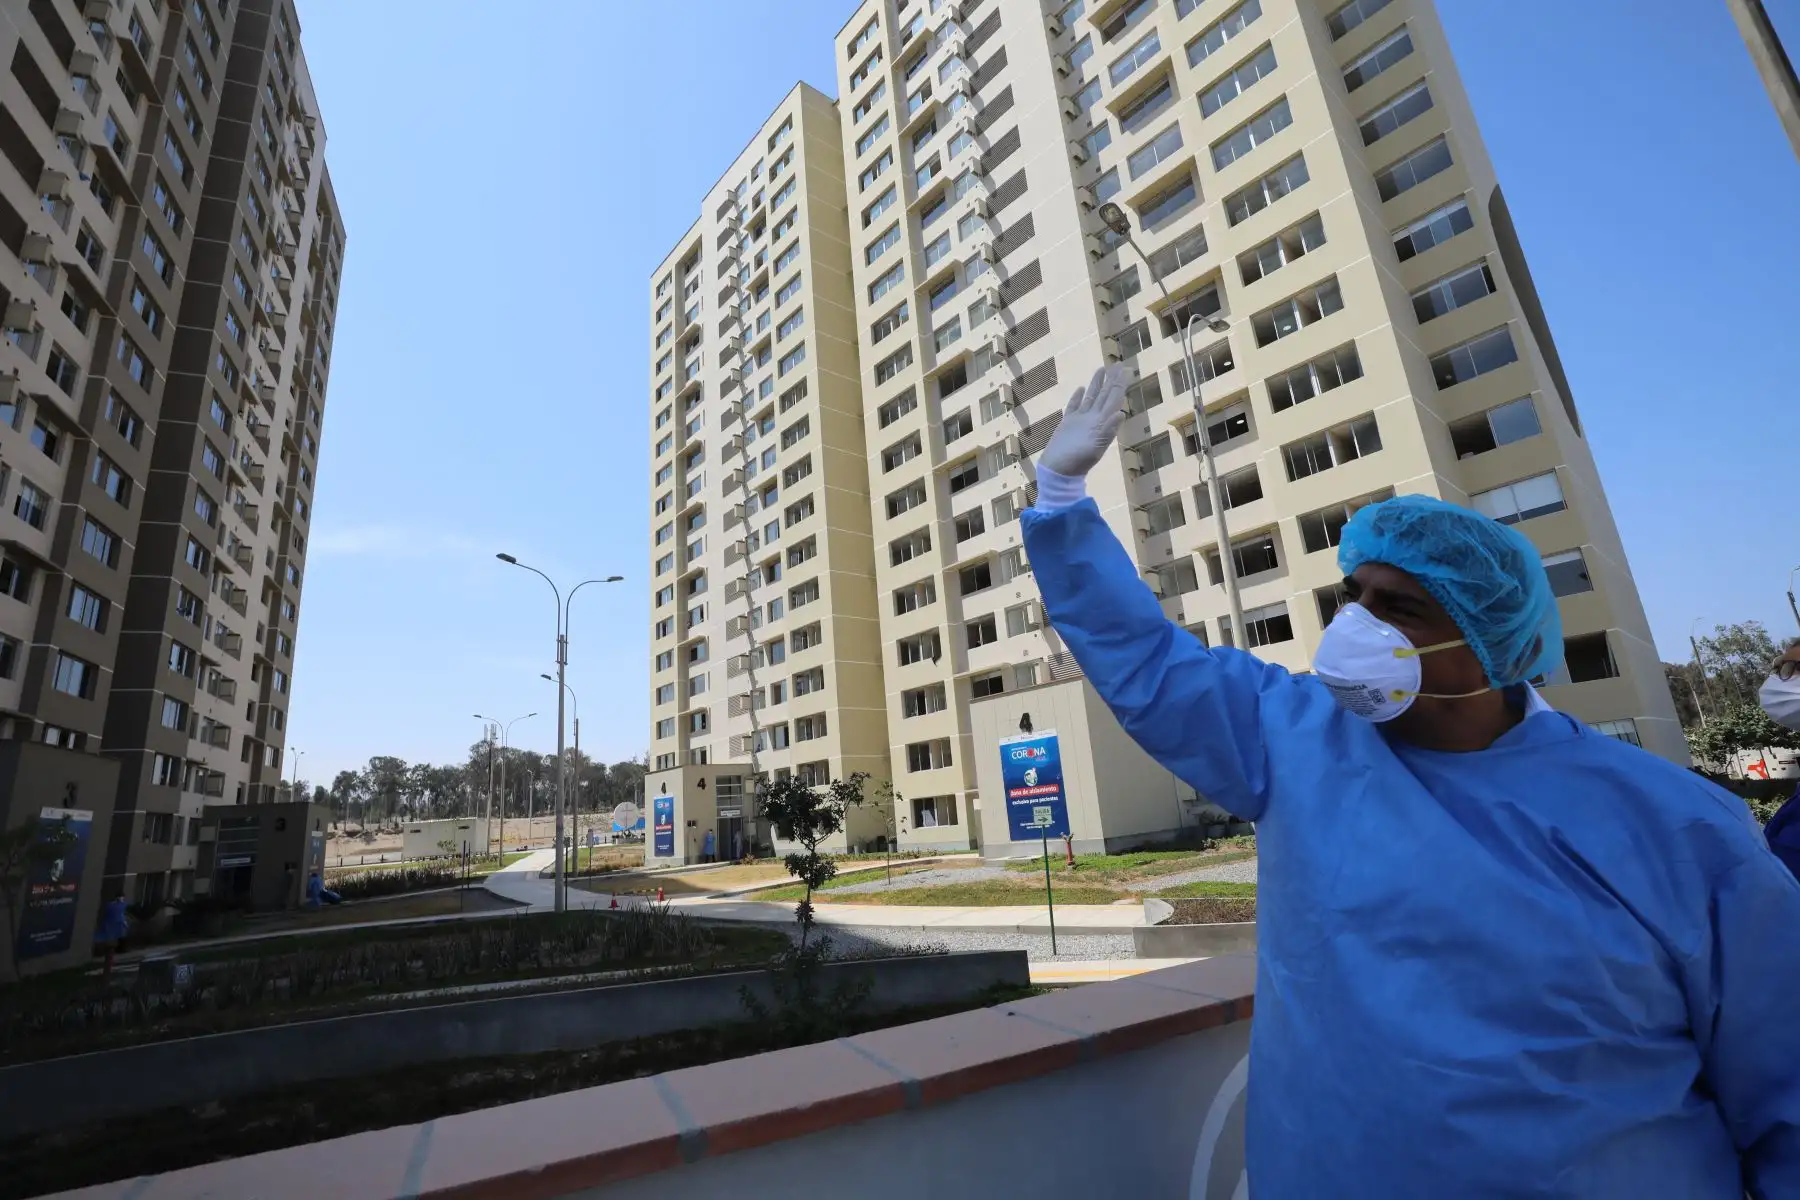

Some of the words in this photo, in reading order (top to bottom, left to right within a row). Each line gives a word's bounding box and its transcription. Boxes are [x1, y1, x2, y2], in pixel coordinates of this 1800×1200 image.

[1019, 712, 1034, 735] 4
[1011, 746, 1046, 759] CORONA
[661, 781, 667, 795] 4
[697, 778, 706, 790] 4
[275, 817, 286, 831] 3
